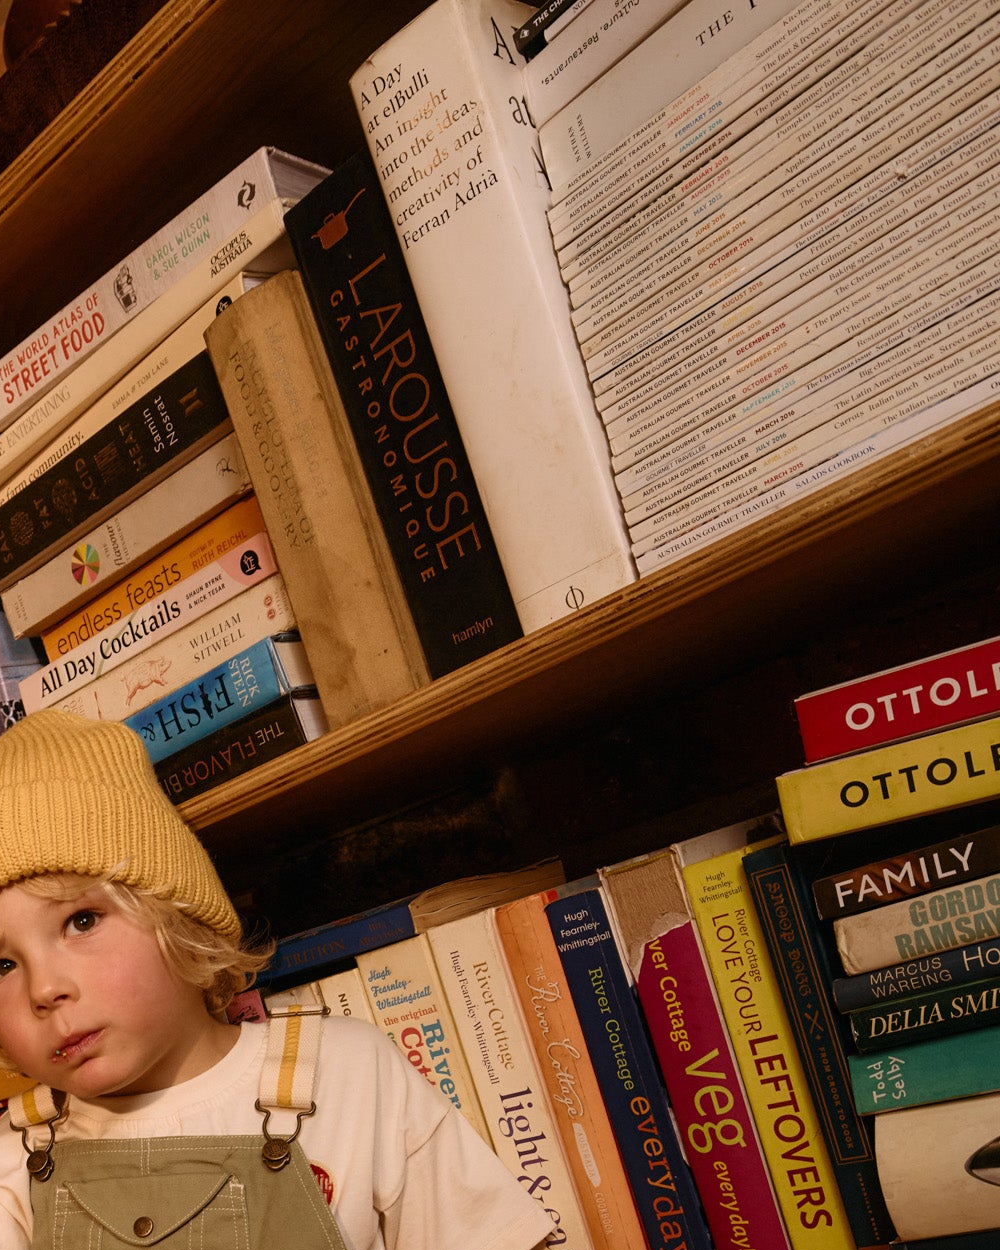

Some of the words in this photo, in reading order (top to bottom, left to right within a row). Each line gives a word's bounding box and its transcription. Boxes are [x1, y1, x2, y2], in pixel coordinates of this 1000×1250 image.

[356, 91, 372, 111] A
[372, 63, 401, 97] Day
[367, 114, 379, 134] at
[382, 67, 429, 118] elBulli
[375, 133, 394, 157] An
[395, 87, 448, 136] insight
[379, 151, 408, 181] into
[406, 123, 437, 157] the
[433, 89, 479, 135] ideas
[387, 147, 447, 204] methods
[454, 114, 483, 151] and
[395, 170, 459, 227] creativity
[466, 143, 483, 170] of
[401, 208, 450, 250] Ferran
[454, 169, 498, 211] Adrià
[573, 219, 611, 249] AUSTRALIAN
[609, 196, 641, 222] GOURMET
[638, 173, 675, 201] TRAVELLER
[680, 141, 718, 171] NOVEMBER
[717, 128, 734, 145] 2014
[142, 240, 176, 271] CAROL
[172, 211, 210, 245] WILSON
[151, 267, 162, 280] &
[159, 253, 181, 274] SUE
[178, 228, 213, 259] QUINN
[206, 236, 253, 278] AUSTRALIA
[207, 229, 249, 265] OCTOPUS
[597, 314, 637, 343] AUSTRALIAN
[634, 295, 666, 319] GOURMET
[664, 271, 701, 299] TRAVELLER
[706, 244, 740, 271] OCTOBER
[738, 236, 755, 249] 2014
[14, 333, 52, 365] WORLD
[52, 305, 83, 338] ATLAS
[83, 292, 97, 311] OF
[2, 344, 58, 404] STREET
[60, 311, 104, 360] FOOD
[623, 396, 664, 423] AUSTRALIAN
[661, 377, 694, 400] GOURMET
[692, 356, 729, 383] TRAVELLER
[733, 331, 772, 357] DECEMBER
[770, 320, 788, 336] 2015
[3, 385, 72, 448] ENTERTAINING
[142, 407, 165, 453] Samin
[153, 394, 178, 446] Nosrat
[329, 289, 436, 583] GASTRONOMIQUE
[347, 252, 482, 570] LAROUSSE
[117, 422, 141, 472] HEAT
[74, 457, 99, 499] ACID
[657, 533, 702, 558] AUSTRALIAN
[701, 513, 739, 536] GOURMET
[741, 489, 786, 516] TRAVELLER
[795, 469, 827, 487] SALADS
[827, 445, 875, 472] COOKBOOK
[32, 497, 51, 529] FAT
[188, 548, 218, 570] RUTH
[214, 529, 248, 555] REICHL
[56, 601, 122, 655] endless
[125, 562, 181, 610] feasts
[183, 584, 205, 600] SHAUN
[204, 573, 222, 588] BYRNE
[186, 600, 194, 610] &
[191, 592, 208, 605] NICK
[207, 582, 225, 596] TESAR
[41, 666, 63, 698] All
[59, 645, 103, 687] Day
[99, 600, 181, 659] Cocktails
[188, 612, 241, 649] WILLIAM
[193, 628, 242, 662] SITWELL
[451, 616, 493, 644] hamlyn
[226, 658, 253, 709] STEIN
[239, 656, 260, 697] RICK
[844, 661, 1000, 729] OTTOL
[154, 672, 234, 742] FISH
[254, 720, 285, 746] THE
[181, 734, 257, 786] FLAVOR
[834, 841, 973, 908] FAMILY
[557, 930, 611, 952] Whittingstall
[559, 921, 600, 938] Fearnley-
[563, 909, 588, 922] Hugh
[733, 907, 749, 936] River
[743, 938, 762, 982] Cottage
[869, 956, 942, 985] MARCUS
[367, 965, 391, 985] Hugh
[370, 978, 411, 997] Fearnley-
[375, 984, 431, 1014] Whittingstall
[870, 968, 952, 998] WAREING
[381, 1014, 399, 1028] the
[399, 1003, 437, 1021] original
[449, 949, 465, 977] Hugh
[458, 977, 500, 1085] Fearnley-Whittingstall
[472, 960, 495, 1006] River
[487, 1007, 514, 1069] Cottage
[587, 965, 611, 1014] River
[604, 1018, 634, 1090] Cottage
[868, 1001, 944, 1038] DELIA
[526, 974, 562, 1036] River
[546, 1037, 583, 1121] Cottage
[659, 975, 691, 1051] Cottage
[684, 1047, 747, 1153] veg
[711, 912, 744, 970] LOVE
[729, 971, 762, 1034] YOUR
[747, 1033, 833, 1229] LEFTOVERS
[866, 1060, 886, 1104] Todd
[886, 1055, 906, 1099] Selby
[497, 1086, 548, 1170] light
